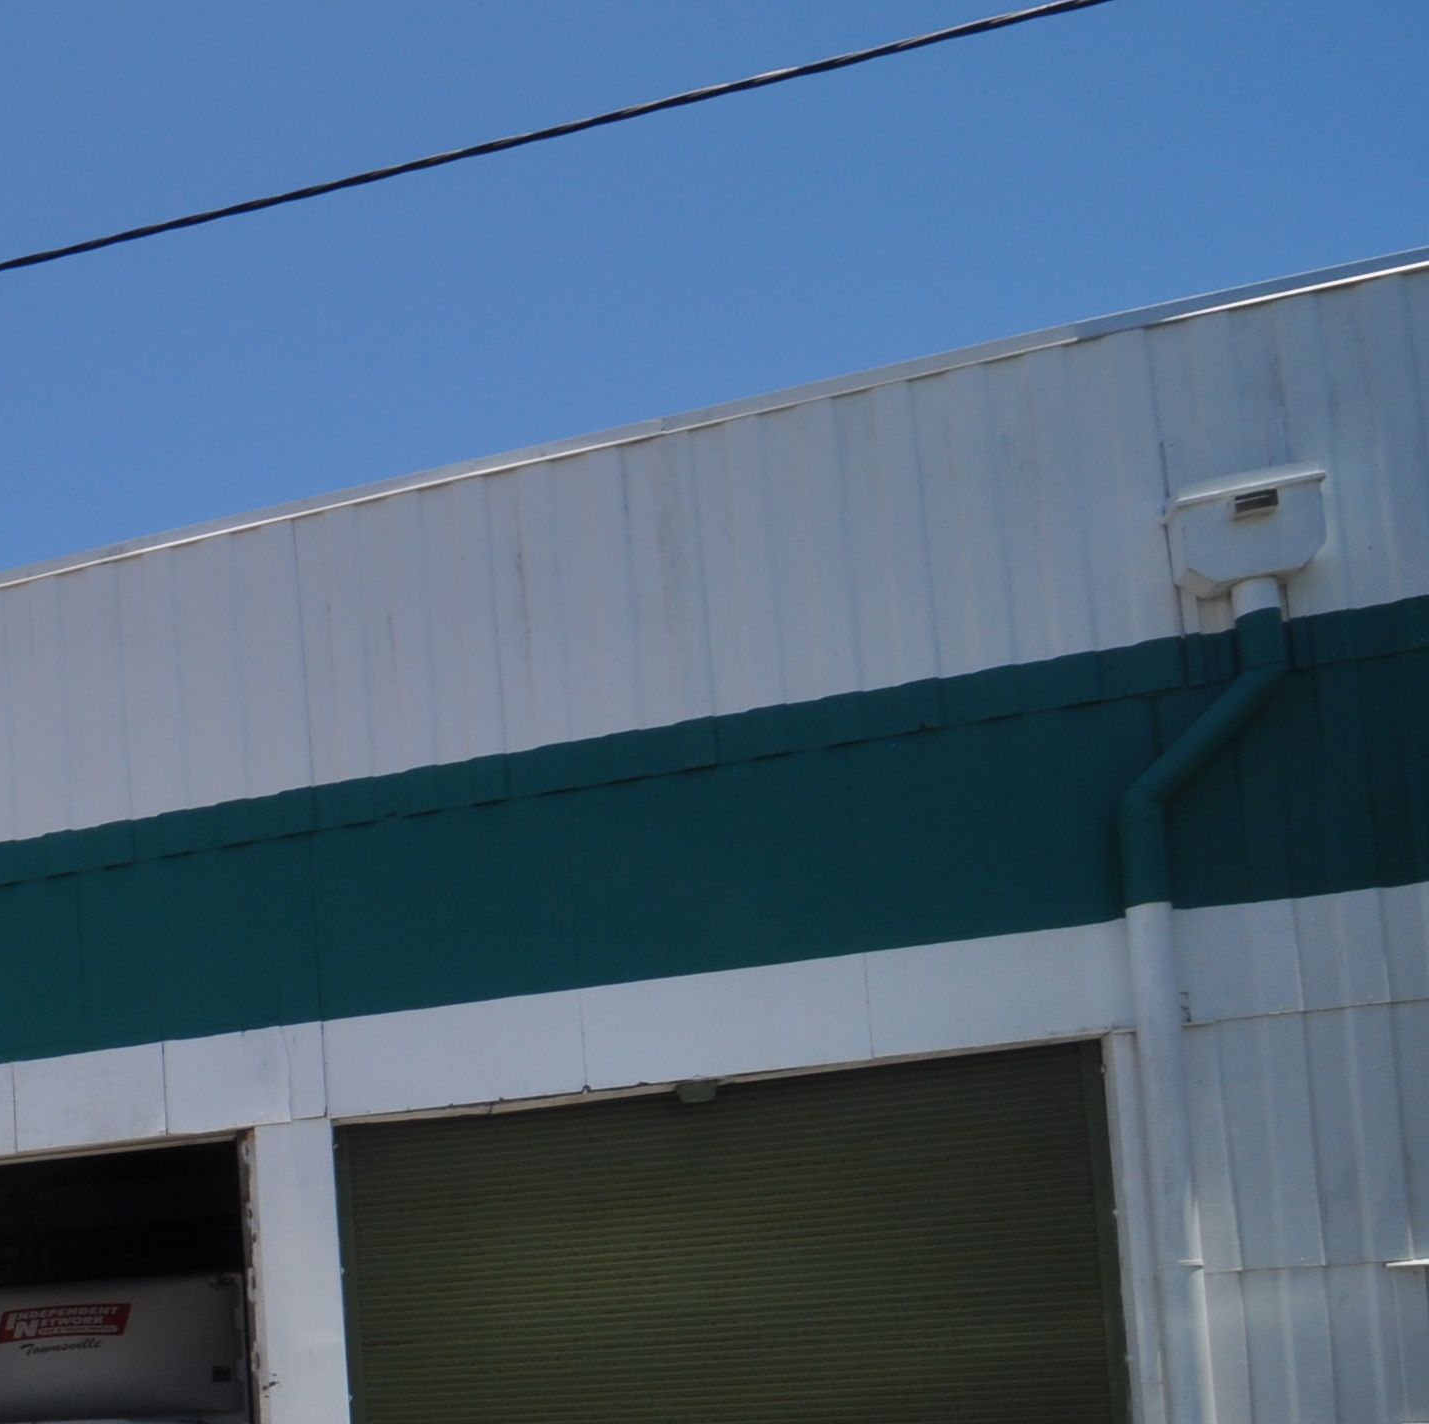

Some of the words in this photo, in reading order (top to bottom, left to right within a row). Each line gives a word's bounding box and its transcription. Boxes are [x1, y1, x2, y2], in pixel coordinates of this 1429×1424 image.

[5, 1306, 119, 1331] INDEPENDENT
[13, 1315, 104, 1339] NETWORK
[20, 1338, 102, 1357] Townsville
